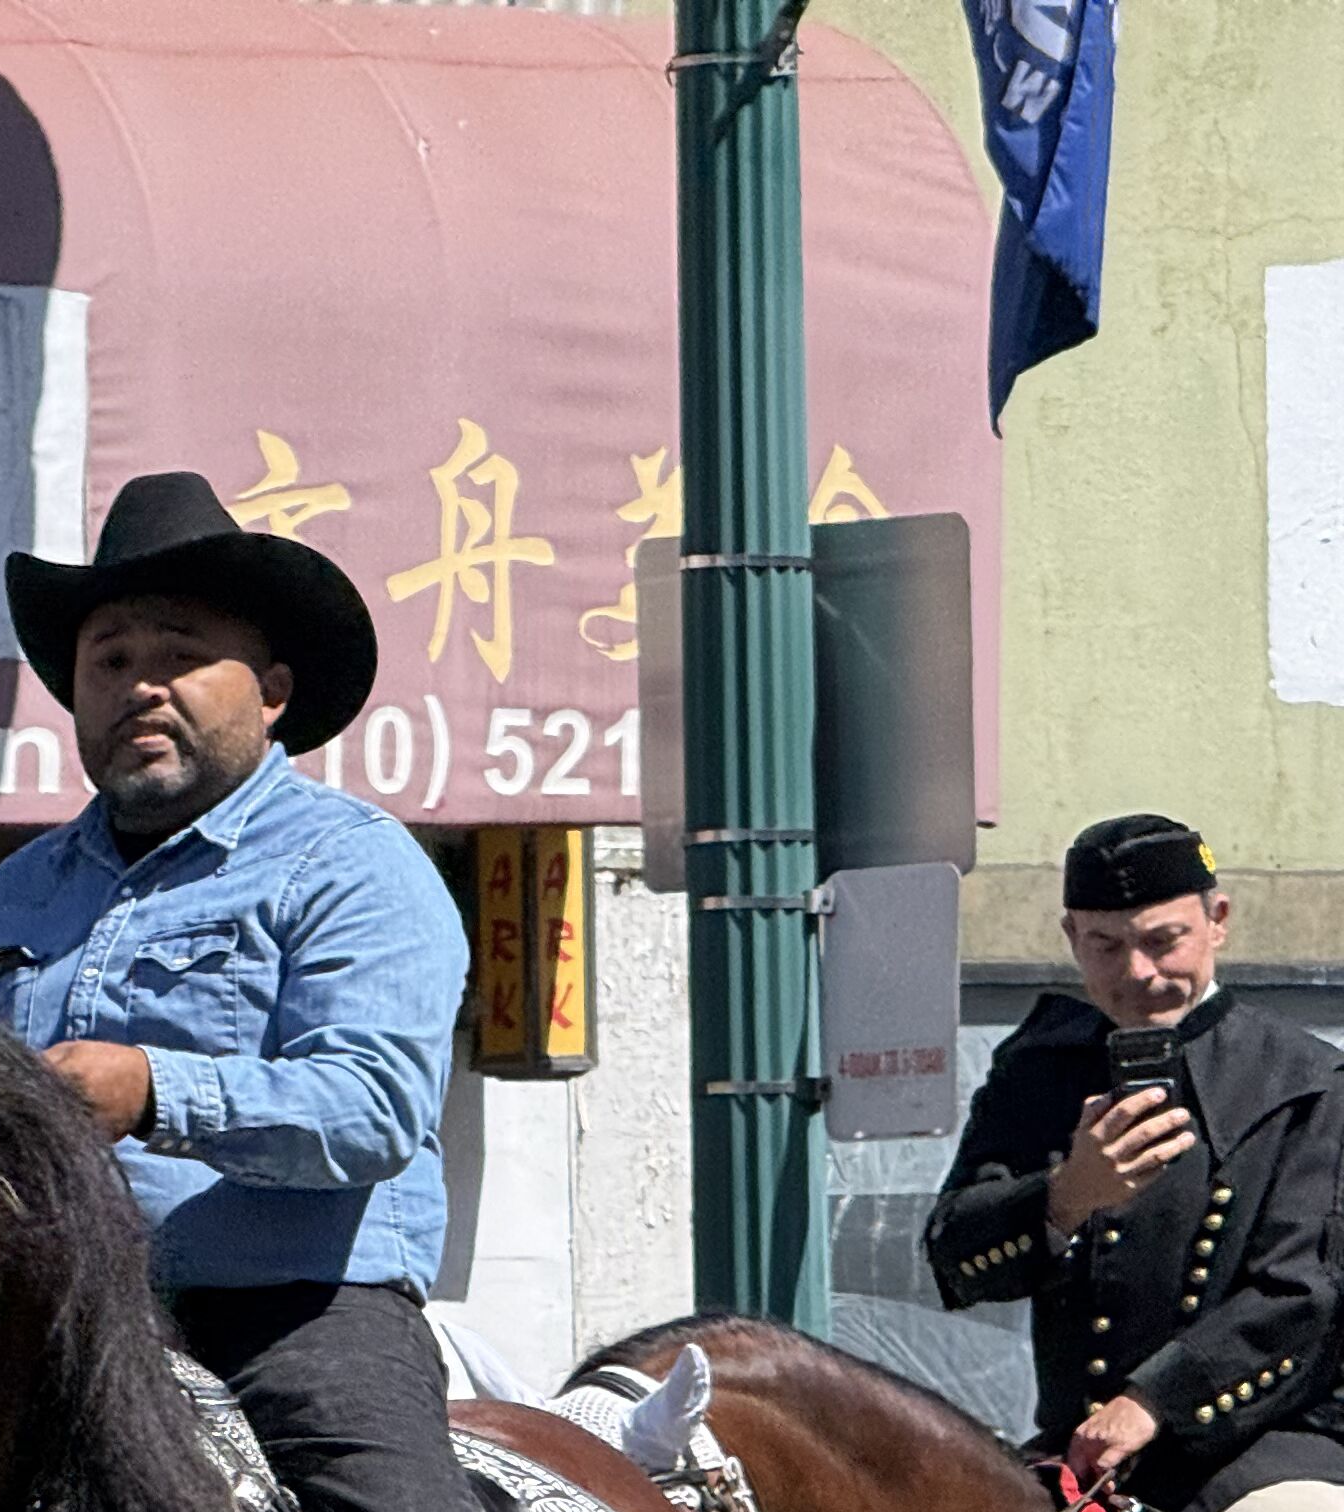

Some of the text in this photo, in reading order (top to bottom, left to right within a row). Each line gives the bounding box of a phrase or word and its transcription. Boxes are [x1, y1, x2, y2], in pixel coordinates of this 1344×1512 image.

[288, 694, 450, 810] 10)
[488, 852, 519, 1030] ARK
[543, 852, 575, 1030] ARK
